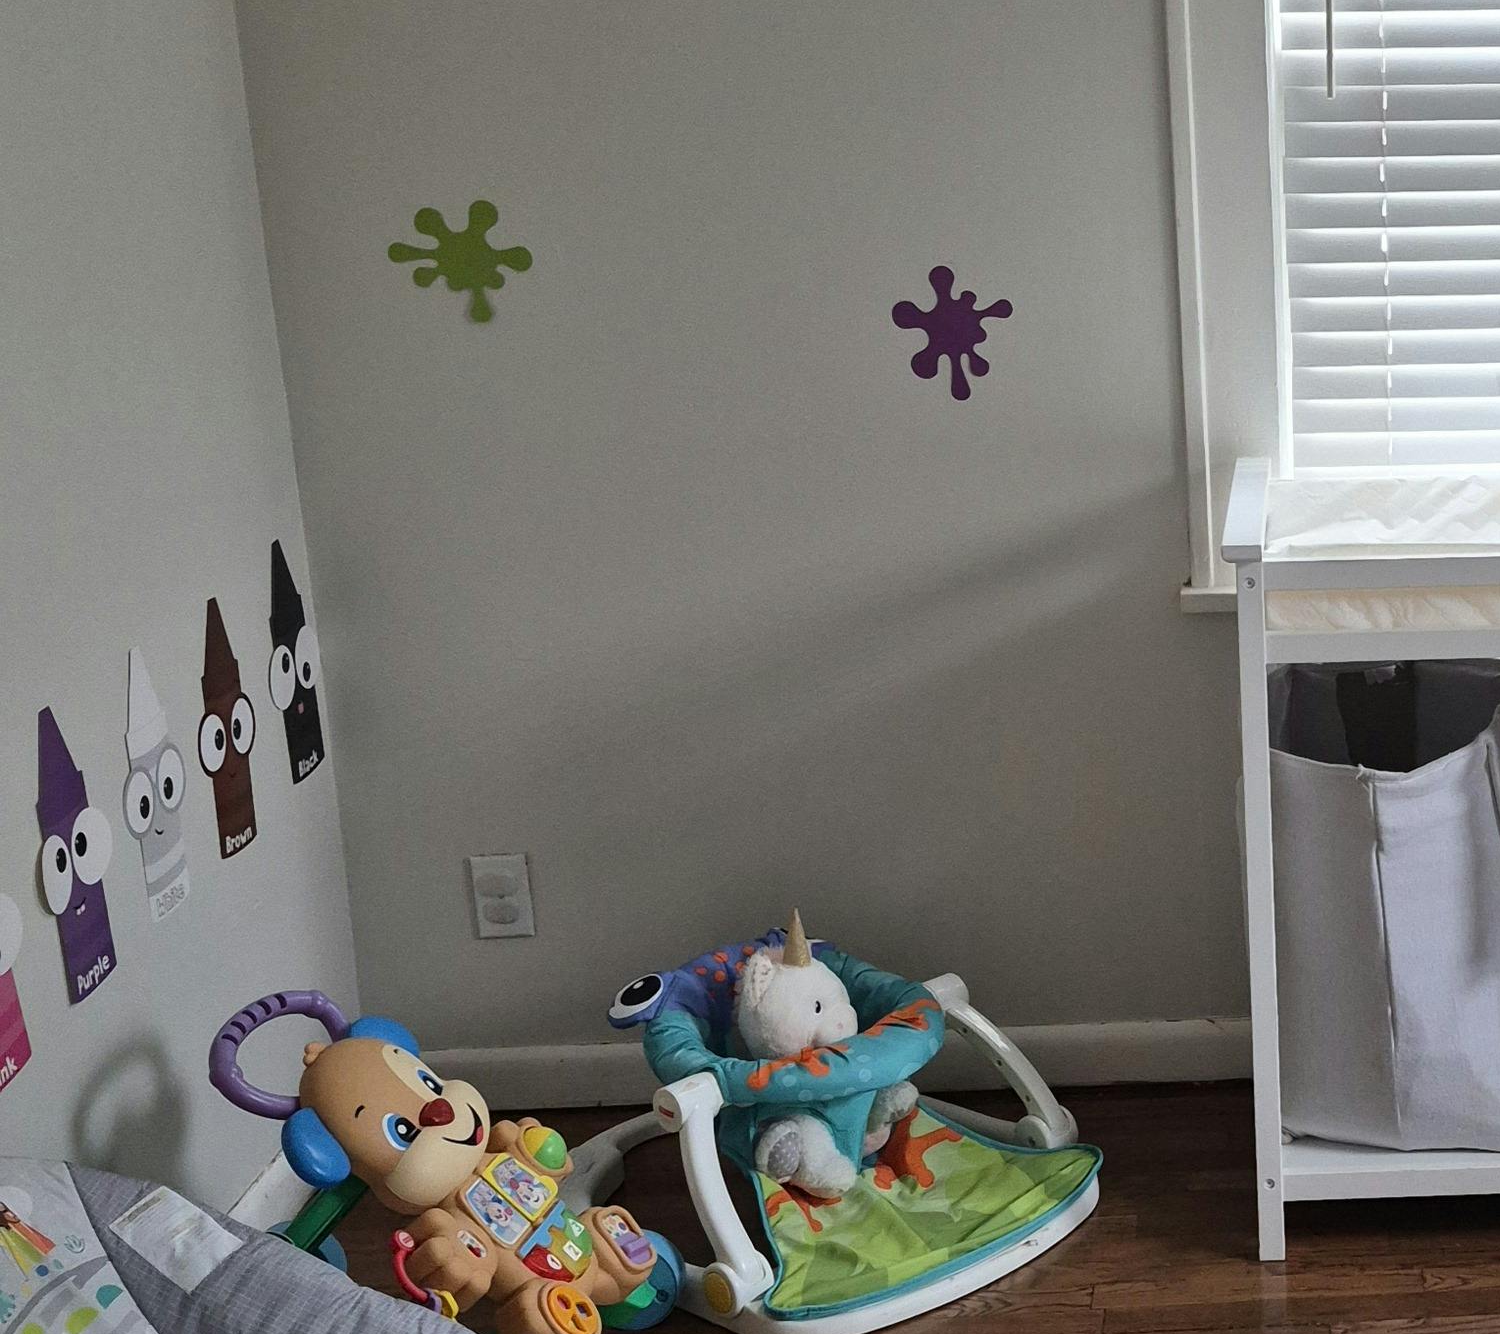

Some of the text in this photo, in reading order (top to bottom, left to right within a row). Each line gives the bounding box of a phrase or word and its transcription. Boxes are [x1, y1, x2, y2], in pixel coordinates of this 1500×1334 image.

[298, 750, 319, 778] Black
[224, 826, 253, 854] Brown
[77, 954, 110, 995] Purple
[0, 1056, 18, 1086] nk
[566, 1243, 580, 1256] 2
